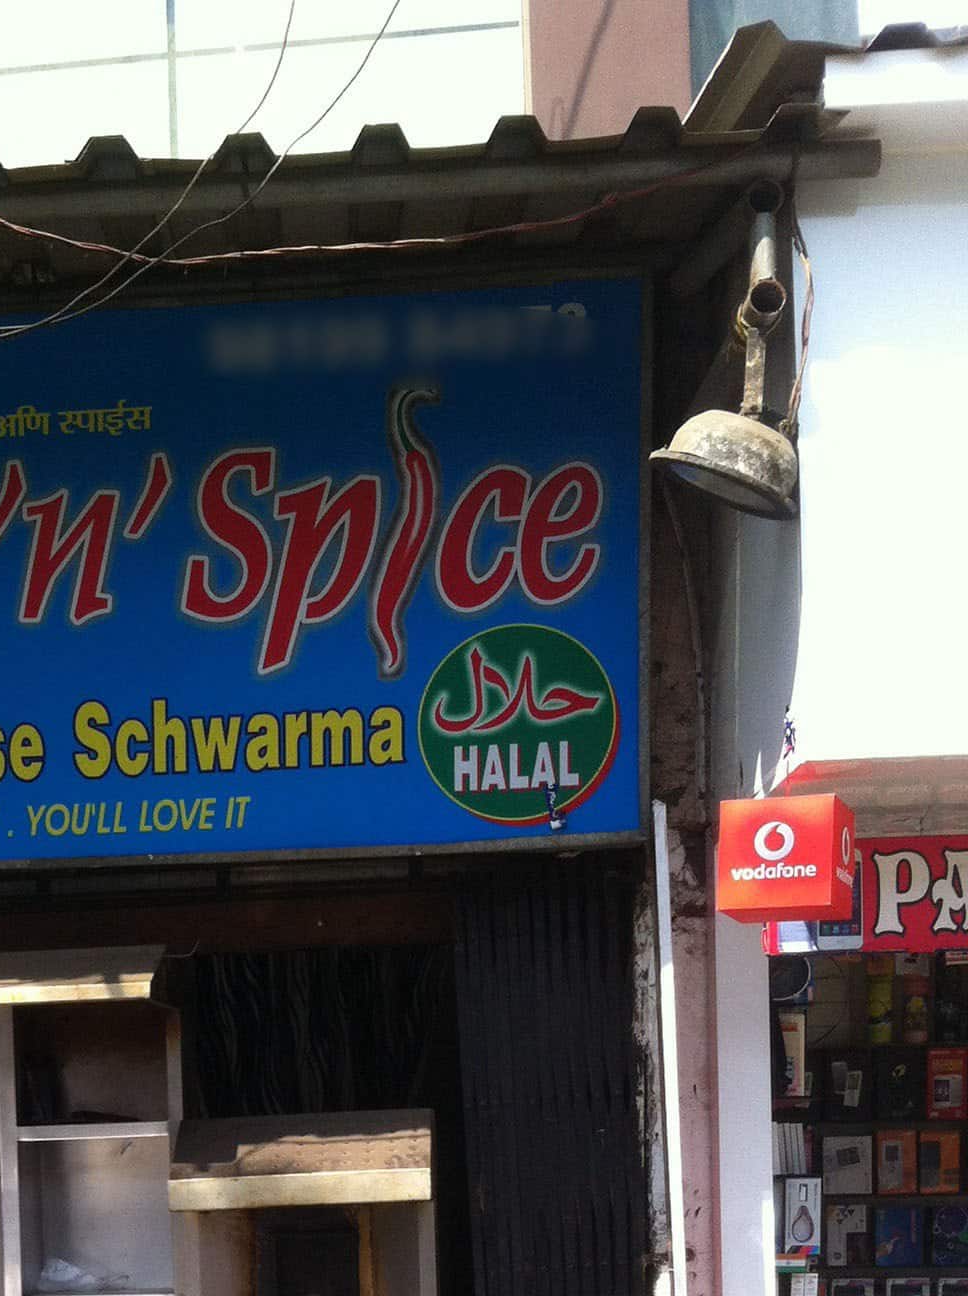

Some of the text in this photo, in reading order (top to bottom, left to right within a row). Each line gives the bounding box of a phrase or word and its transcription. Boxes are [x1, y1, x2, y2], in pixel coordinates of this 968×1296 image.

[57, 400, 152, 436] स्पाईस
[181, 388, 603, 678] Spice
[433, 647, 600, 733] حلال
[73, 697, 405, 780] Schwarma
[453, 741, 581, 793] HALAL
[27, 801, 127, 837] YOU'LL
[139, 798, 216, 832] LOVE
[224, 796, 251, 829] IT
[731, 863, 816, 881] vodafone
